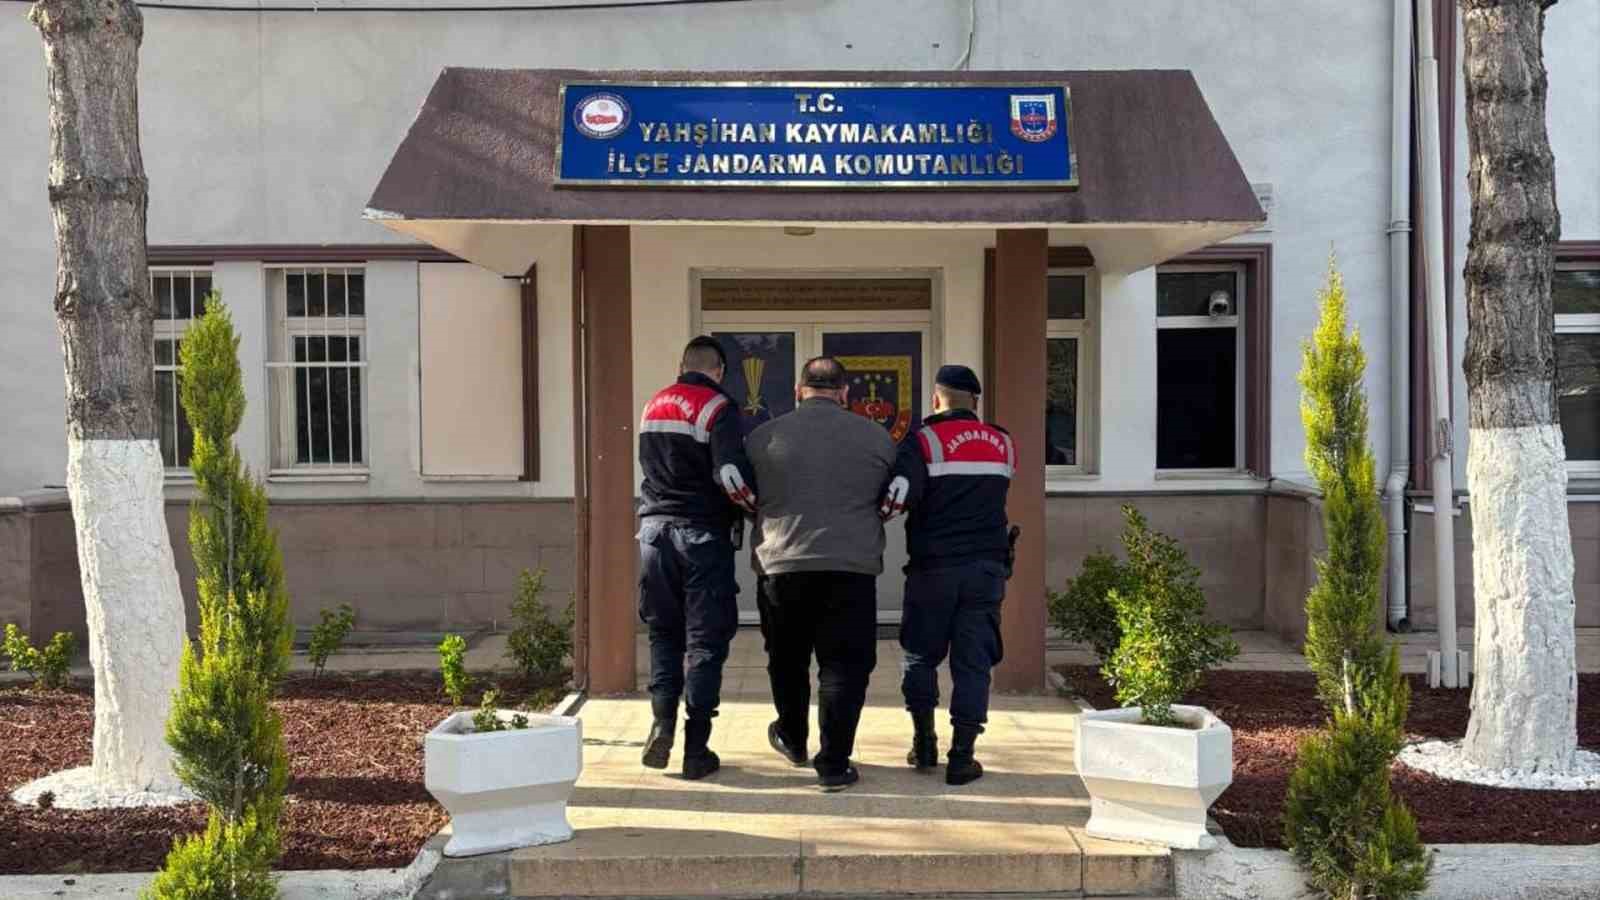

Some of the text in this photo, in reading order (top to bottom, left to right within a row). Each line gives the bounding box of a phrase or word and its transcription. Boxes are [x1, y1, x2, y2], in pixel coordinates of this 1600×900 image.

[795, 93, 843, 112] T.C.
[639, 118, 776, 147] YAHŞİHAN
[785, 119, 992, 143] KAYMAKAMLIĞI
[607, 148, 1023, 177] İLÇE JANDARMA KOMUTANLIĞI
[947, 430, 1005, 455] JANDARMA
